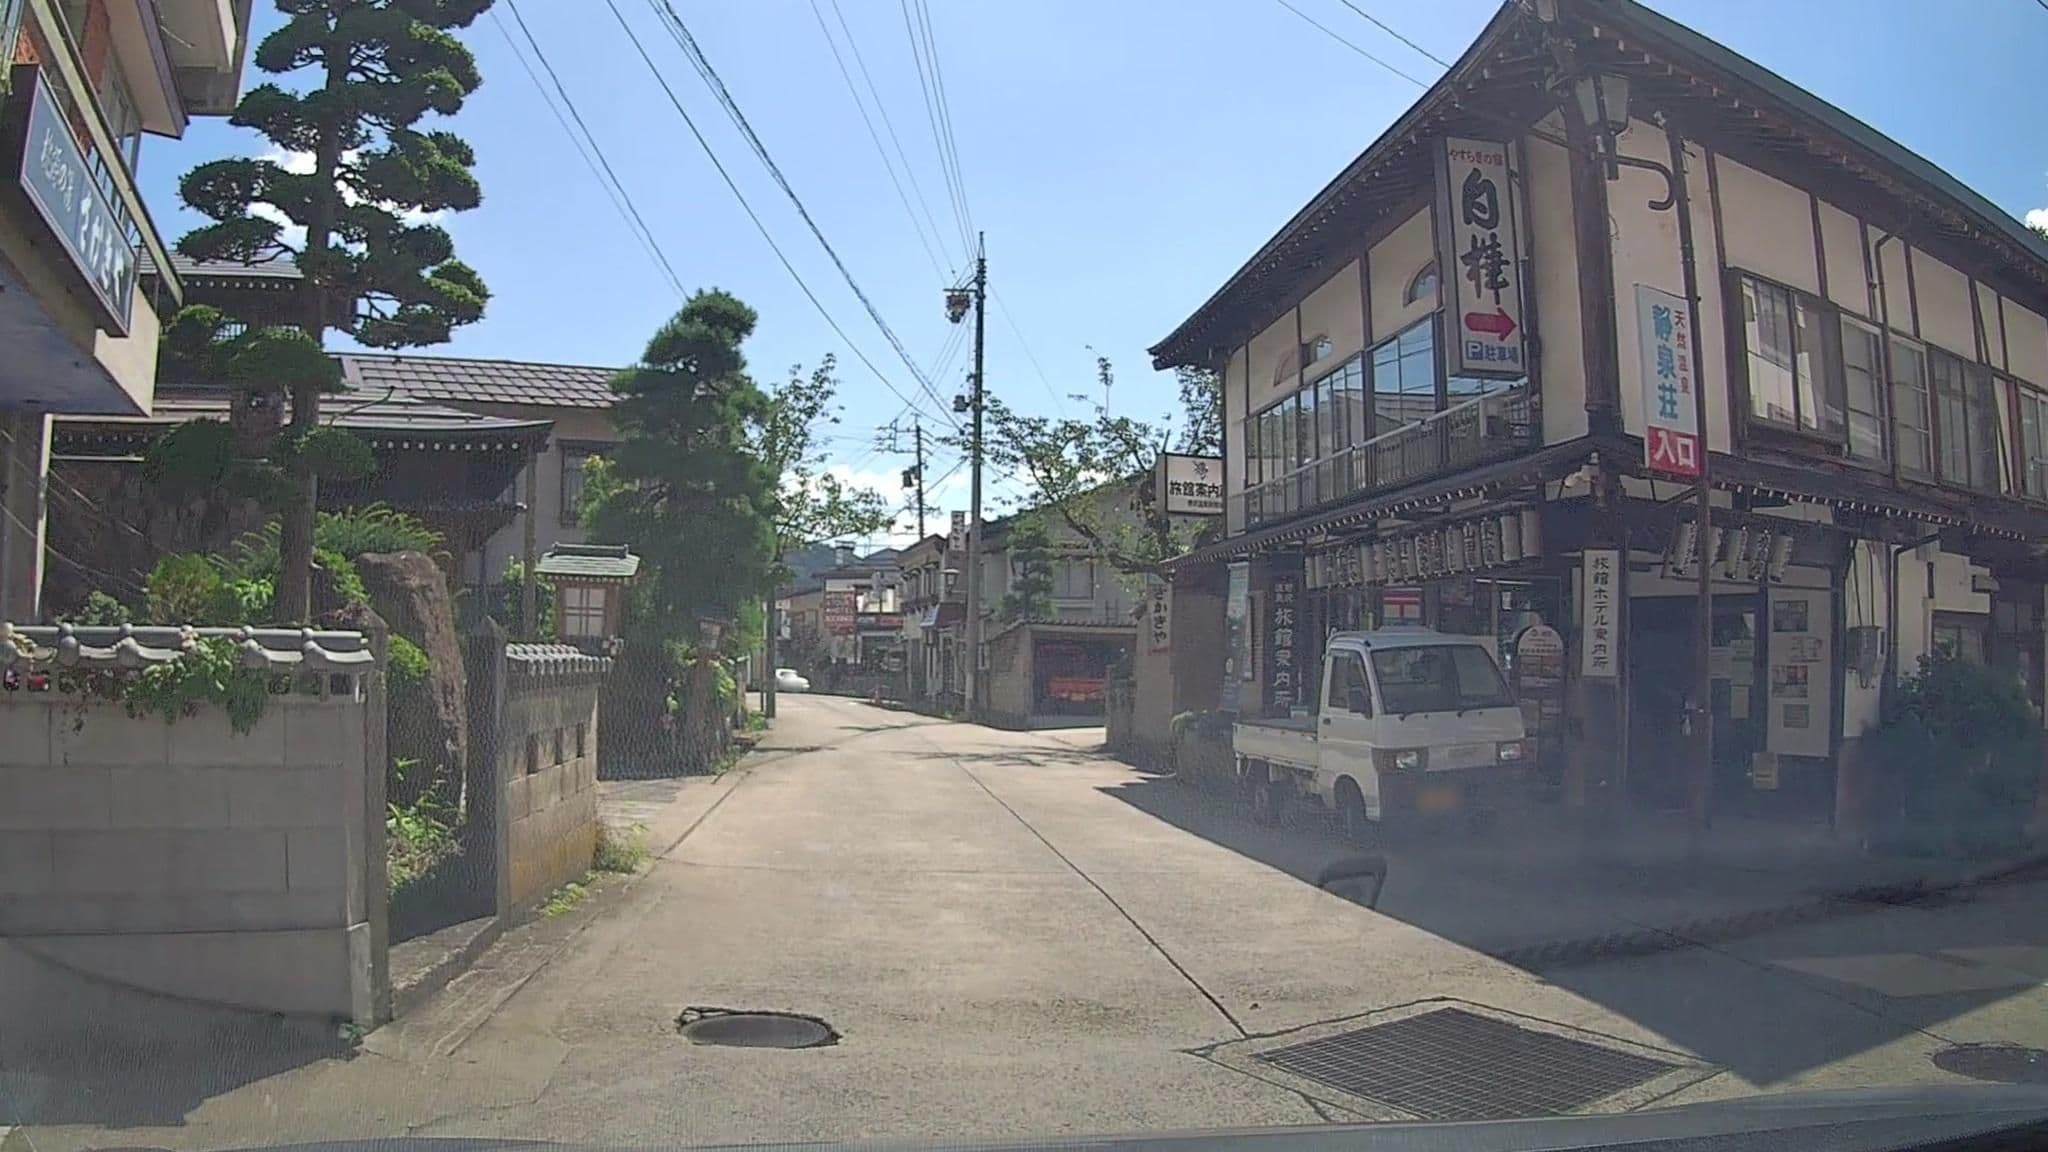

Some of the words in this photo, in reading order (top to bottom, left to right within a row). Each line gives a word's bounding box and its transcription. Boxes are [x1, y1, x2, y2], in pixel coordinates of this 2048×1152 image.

[1459, 167, 1511, 305] 白樺
[1653, 430, 1696, 468] 入口
[1153, 585, 1168, 644] さかきや
[1272, 607, 1294, 708] 旅館案内所
[1592, 557, 1611, 670] 旅館ホテル案内所
